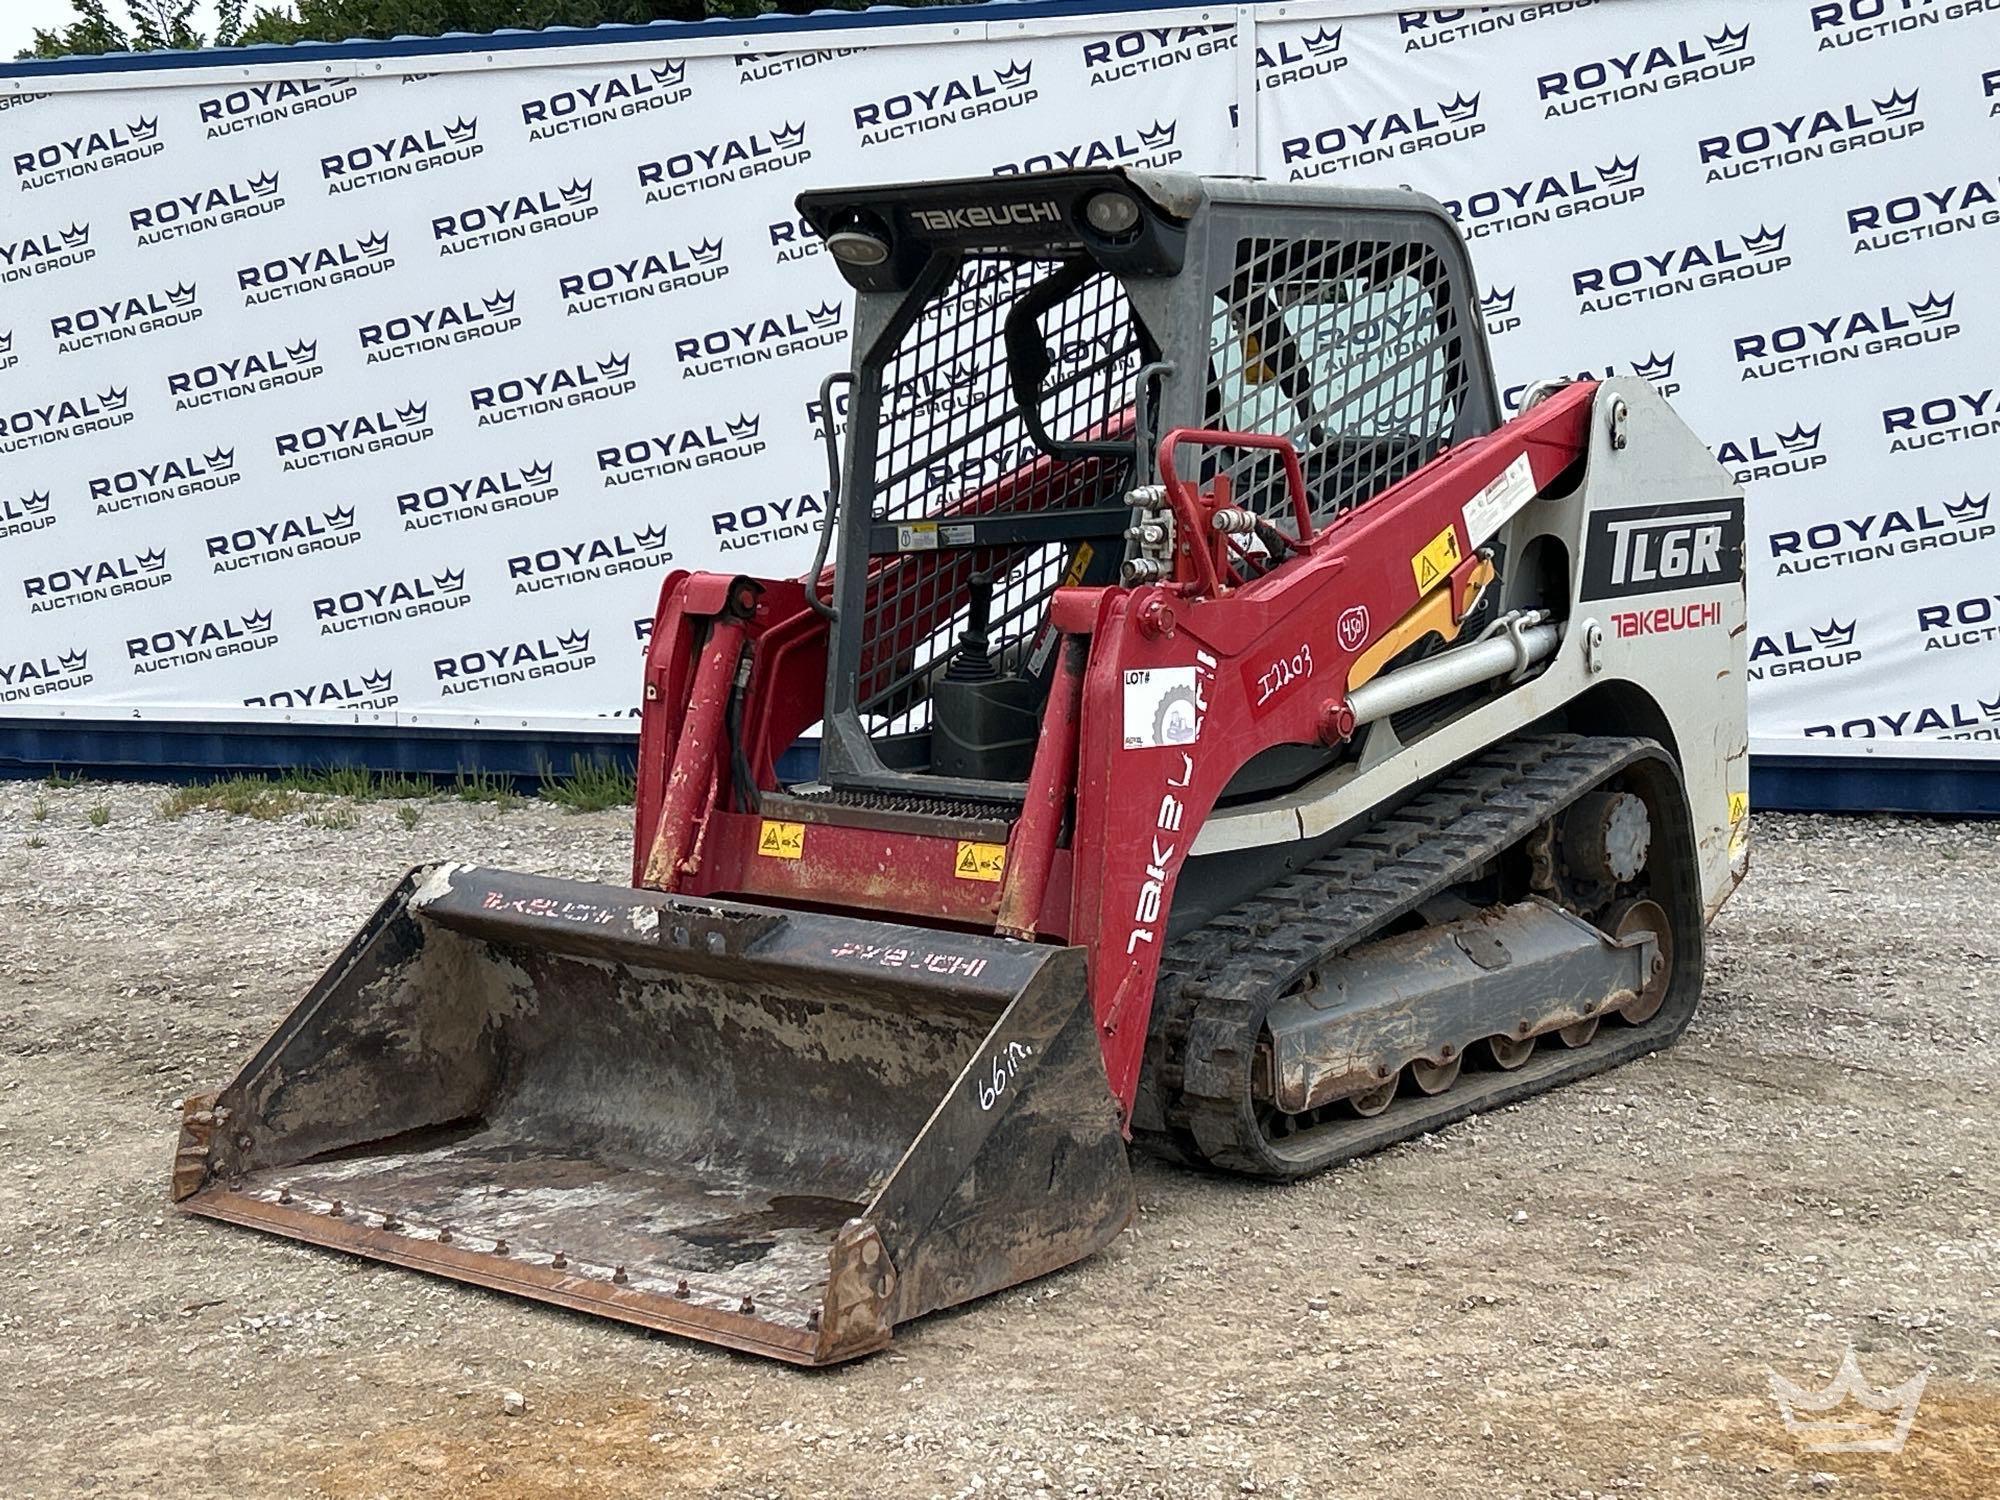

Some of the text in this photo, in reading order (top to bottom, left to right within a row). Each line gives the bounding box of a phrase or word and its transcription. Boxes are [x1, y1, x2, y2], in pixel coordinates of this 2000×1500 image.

[1083, 24, 1237, 68] ROYA
[1405, 14, 1514, 53] AUCTION
[1818, 10, 1938, 51] AUCTION
[740, 50, 833, 84] AUCTION
[1091, 48, 1191, 86] AUCTION
[1266, 57, 1348, 88] GROUP
[1537, 40, 1706, 100] ROYAL
[1545, 56, 1755, 119] AUCTION GROUP
[0, 93, 52, 110] GRO
[199, 78, 321, 123] ROYAL
[208, 88, 356, 139] AUCTION GROUP
[522, 74, 652, 124] ROYAL
[530, 88, 692, 142] AUCTION GROUP
[854, 75, 996, 129] ROYAL
[862, 90, 1038, 147] AUCTION GROUP
[14, 128, 129, 176] ROYAL
[320, 130, 446, 178] ROYAL
[1282, 108, 1439, 164] ROYAL
[1290, 124, 1485, 182] AUCTION GROUP
[1698, 104, 1873, 164] ROYAL
[1706, 122, 1924, 184] AUCTION GROUP
[22, 142, 164, 191] AUCTION GROUP
[329, 145, 483, 195] AUCTION GROUP
[638, 136, 772, 187] ROYAL
[646, 150, 811, 204] AUCTION GROUP
[130, 184, 250, 230] ROYAL
[138, 198, 285, 247] AUCTION GROUP
[432, 192, 560, 240] ROYAL
[911, 201, 1061, 231] TAKEUCHI
[1556, 187, 1644, 218] GROUP
[1847, 176, 2000, 234] ROYA
[0, 235, 62, 265] YAL
[440, 206, 598, 256] AUCTION GROUP
[777, 241, 827, 264] AUCT
[1854, 216, 1975, 254] AUCTION
[36, 250, 95, 274] GROUP
[238, 244, 358, 290] ROYAL
[246, 259, 394, 307] AUCTION GROUP
[560, 251, 690, 298] ROYAL
[1573, 240, 1742, 296] ROYAL
[568, 266, 728, 316] AUCTION GROUP
[1580, 256, 1791, 314] AUCTION GROUP
[51, 294, 167, 338] ROYAL
[59, 308, 202, 354] AUCTION GROUP
[359, 302, 484, 348] ROYAL
[676, 314, 808, 362] ROYAL
[1734, 307, 1909, 362] ROYAL
[367, 318, 521, 364] AUCTION GROUP
[683, 330, 848, 379] AUCTION GROUP
[1742, 324, 1960, 381] AUCTION GROUP
[168, 351, 287, 395] ROYAL
[176, 366, 323, 411] AUCTION GROUP
[470, 366, 598, 410] ROYAL
[72, 412, 134, 436] GROUP
[478, 381, 636, 426] AUCTION GROUP
[1883, 389, 2000, 434] ROY
[276, 412, 397, 456] ROYAL
[284, 428, 433, 472] AUCTION GROUP
[597, 426, 727, 470] ROYAL
[89, 458, 206, 500] ROYAL
[605, 442, 766, 487] AUCTION GROUP
[1734, 455, 1827, 485] GROUP
[97, 473, 240, 515] AUCTION GROUP
[397, 472, 522, 515] ROYAL
[405, 488, 558, 531] AUCTION GROUP
[206, 516, 325, 558] ROYAL
[214, 532, 360, 574] AUCTION GROUP
[720, 521, 809, 552] AUCTION
[1607, 510, 1732, 585] TL6R
[1770, 506, 1944, 557] ROYAL
[1777, 526, 1995, 576] AUCTION GROUP
[24, 558, 138, 598] ROYAL
[508, 536, 635, 578] ROYAL
[516, 552, 672, 594] AUCTION GROUP
[32, 574, 172, 614] AUCTION GROUP
[313, 579, 434, 620] ROYAL
[322, 595, 470, 636] AUCTION GROUP
[126, 620, 244, 658] ROYAL
[1611, 602, 1721, 638] TAKEUCHI
[1925, 626, 2000, 651] AUCT
[0, 659, 60, 685] YAL
[134, 636, 278, 674] AUCTION GROUP
[434, 640, 558, 680] ROYAL
[442, 656, 596, 696] AUCTION GROUP
[1770, 651, 1862, 676] GROUP
[34, 674, 93, 695] GROUP
[1126, 671, 1150, 685] LOT#
